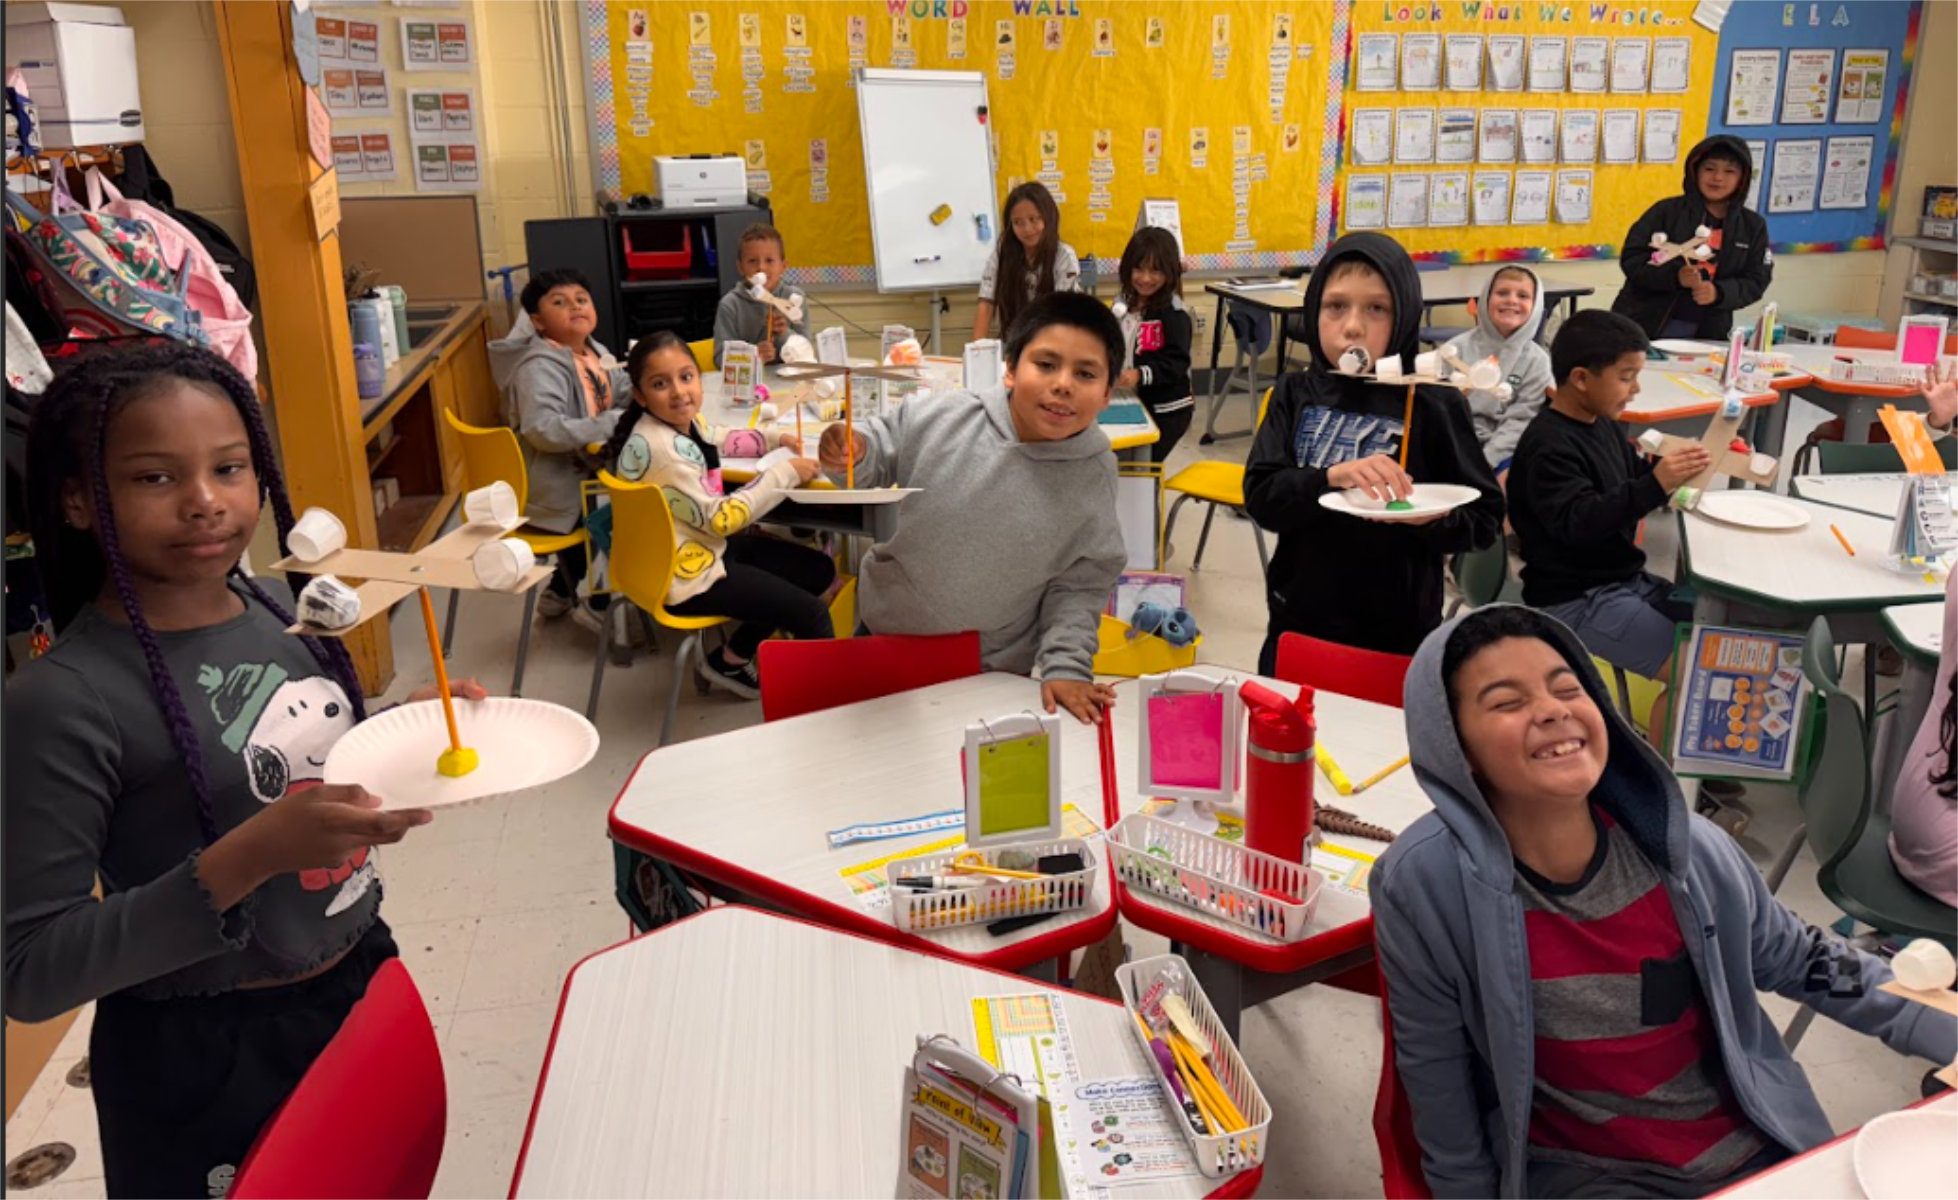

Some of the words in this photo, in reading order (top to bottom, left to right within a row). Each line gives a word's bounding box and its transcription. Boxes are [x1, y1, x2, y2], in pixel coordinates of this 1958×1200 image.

[887, 0, 967, 18] WORD
[1013, 0, 1079, 16] WALL
[1384, 1, 1441, 21] Look
[1461, 1, 1521, 20] What
[1540, 4, 1572, 22] We
[1085, 1088, 1107, 1096] Make
[953, 1106, 965, 1119] of
